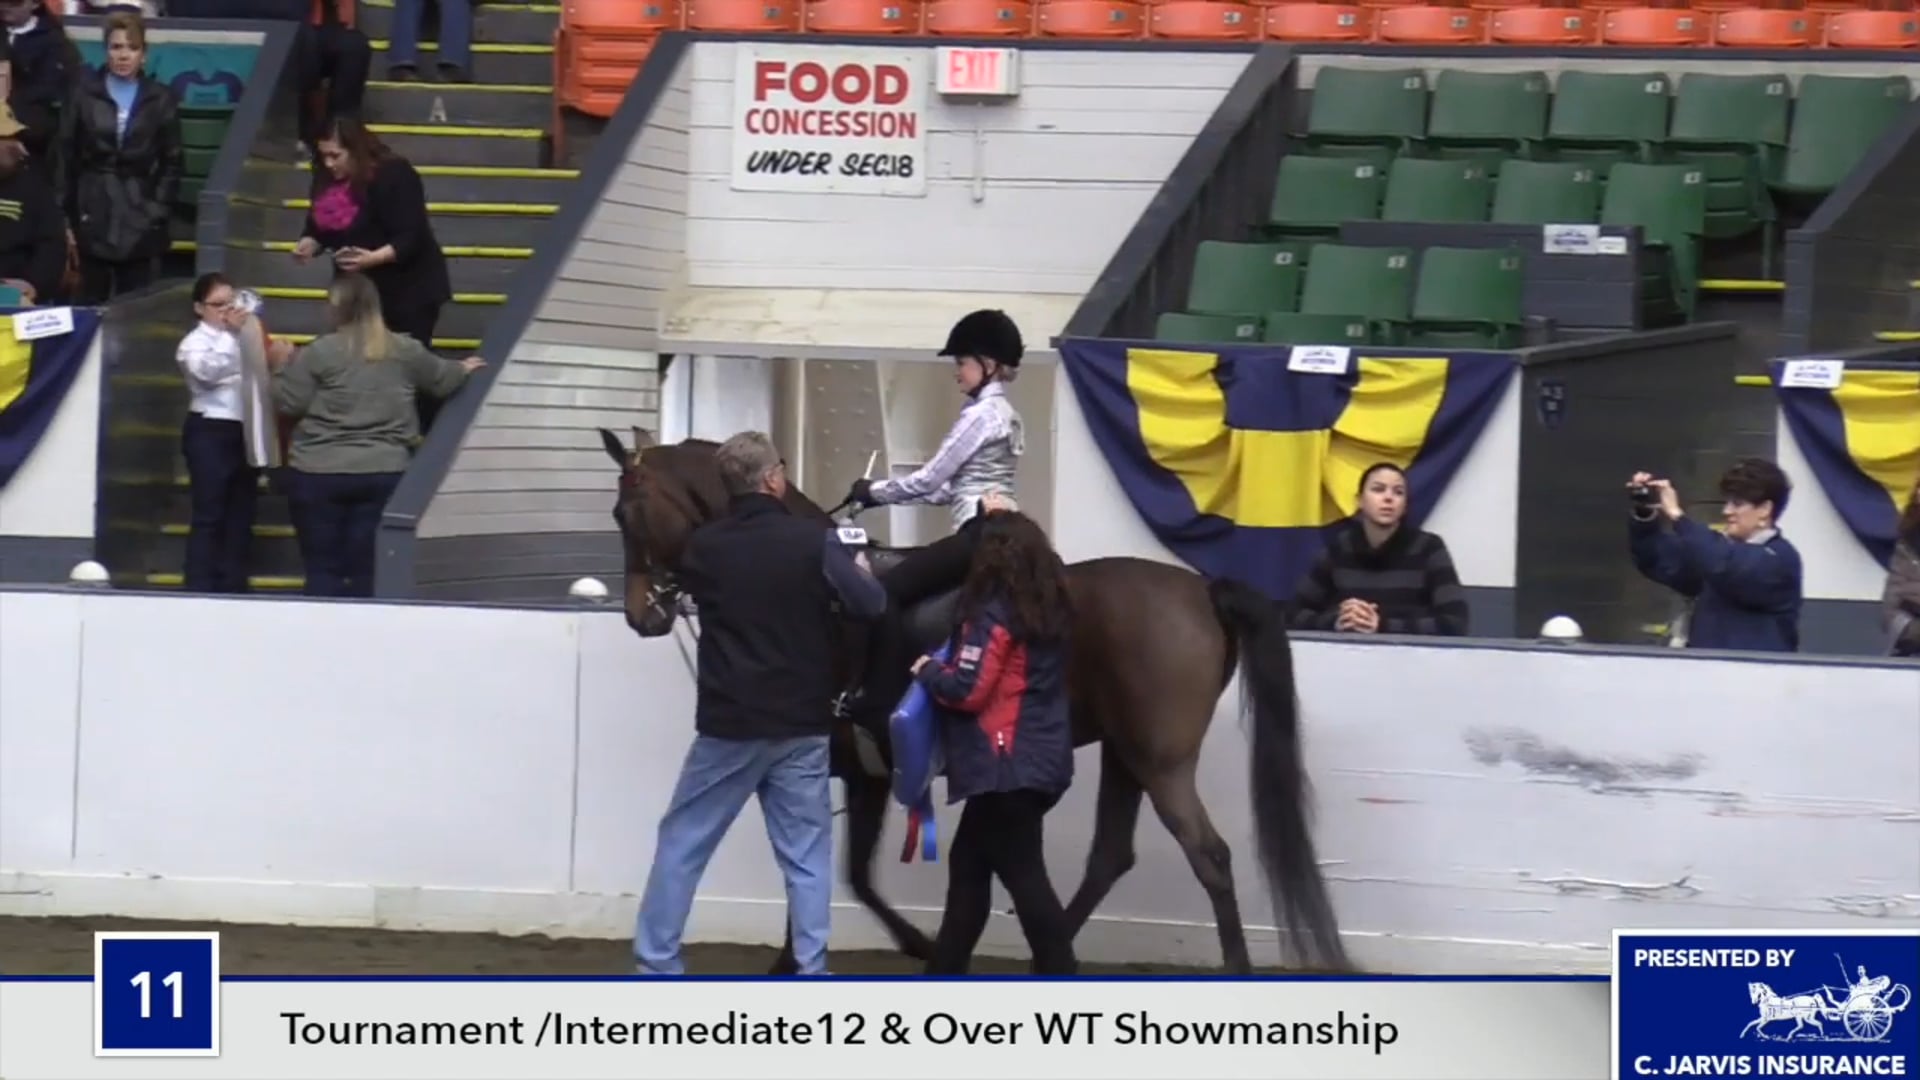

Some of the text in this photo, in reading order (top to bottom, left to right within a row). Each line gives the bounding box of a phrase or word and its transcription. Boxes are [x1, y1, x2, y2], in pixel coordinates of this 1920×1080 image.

[755, 61, 909, 105] FOOD
[949, 50, 1000, 88] EXIT
[429, 96, 447, 122] A
[745, 108, 917, 138] CONCESSION
[746, 150, 832, 175] UNDER
